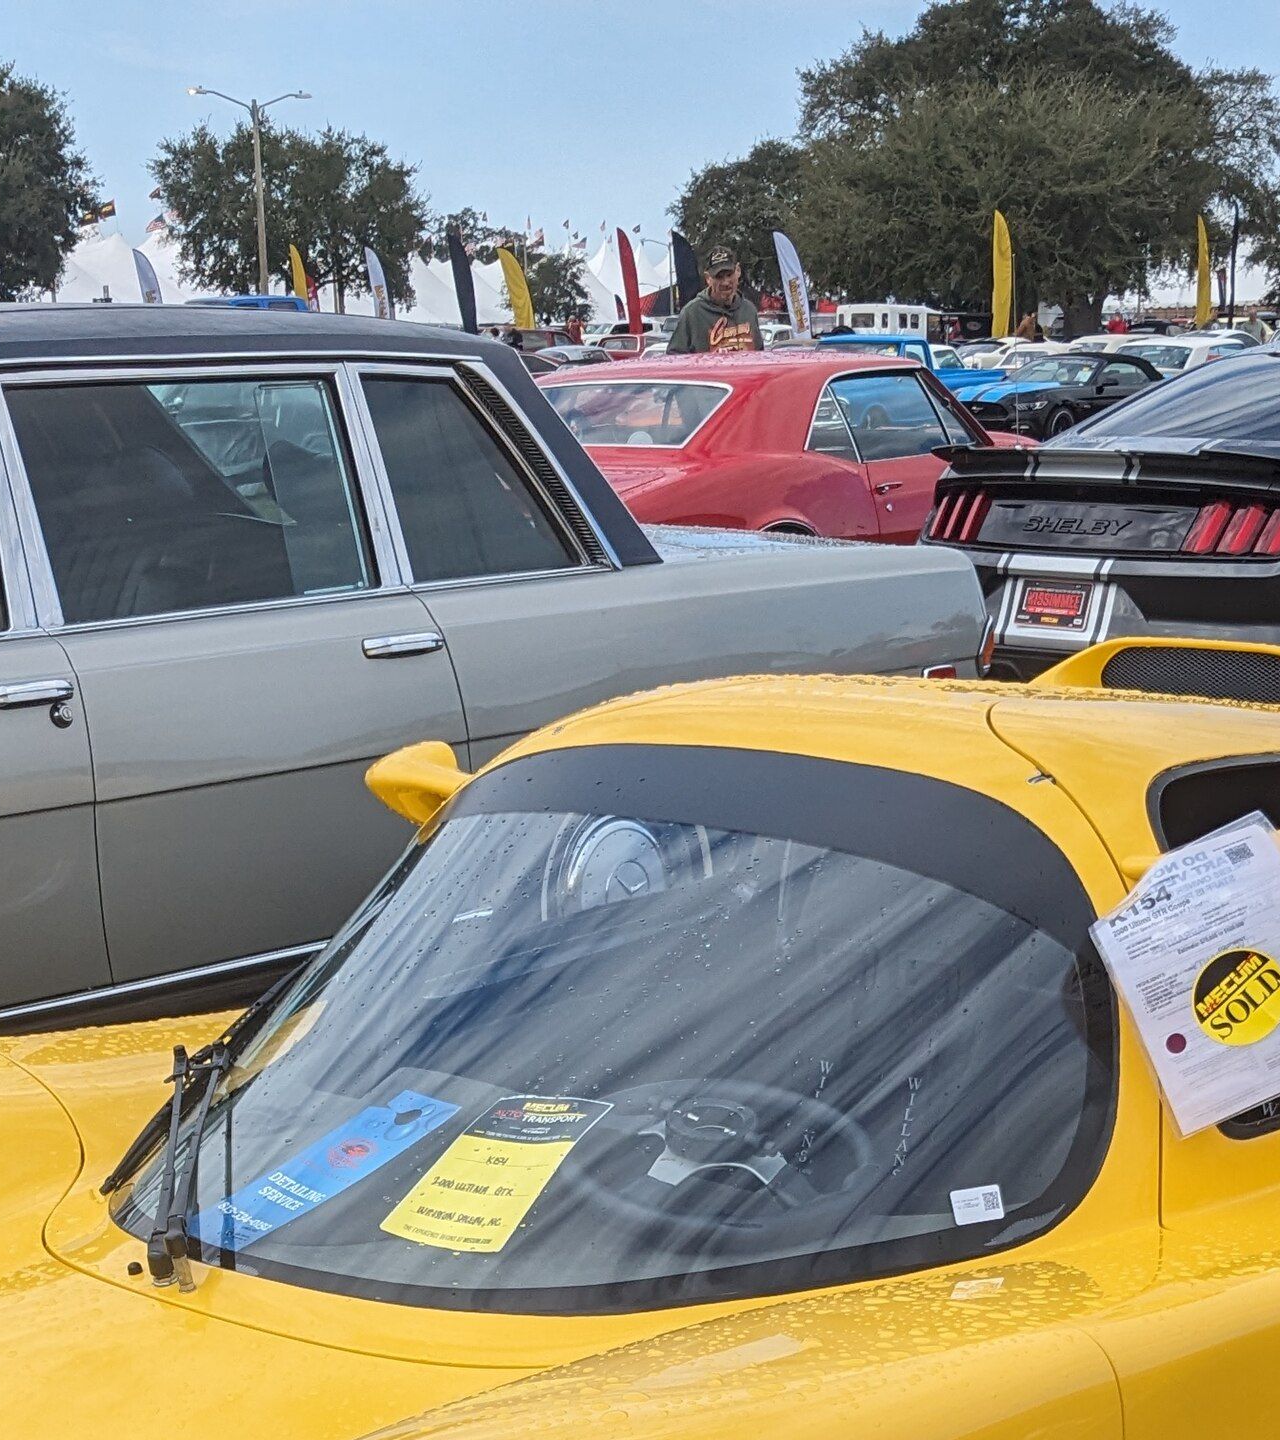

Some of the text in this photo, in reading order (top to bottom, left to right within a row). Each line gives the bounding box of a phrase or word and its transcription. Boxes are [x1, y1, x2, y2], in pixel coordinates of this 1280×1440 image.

[1023, 515, 1132, 537] SHELBY
[1108, 885, 1172, 929] K154
[1196, 955, 1263, 1018] MECUM
[494, 1109, 585, 1124] AUTO TRANSPORT
[522, 1102, 570, 1112] MECUM
[257, 1185, 304, 1211] SERVICE
[267, 1171, 327, 1204] DETAILING
